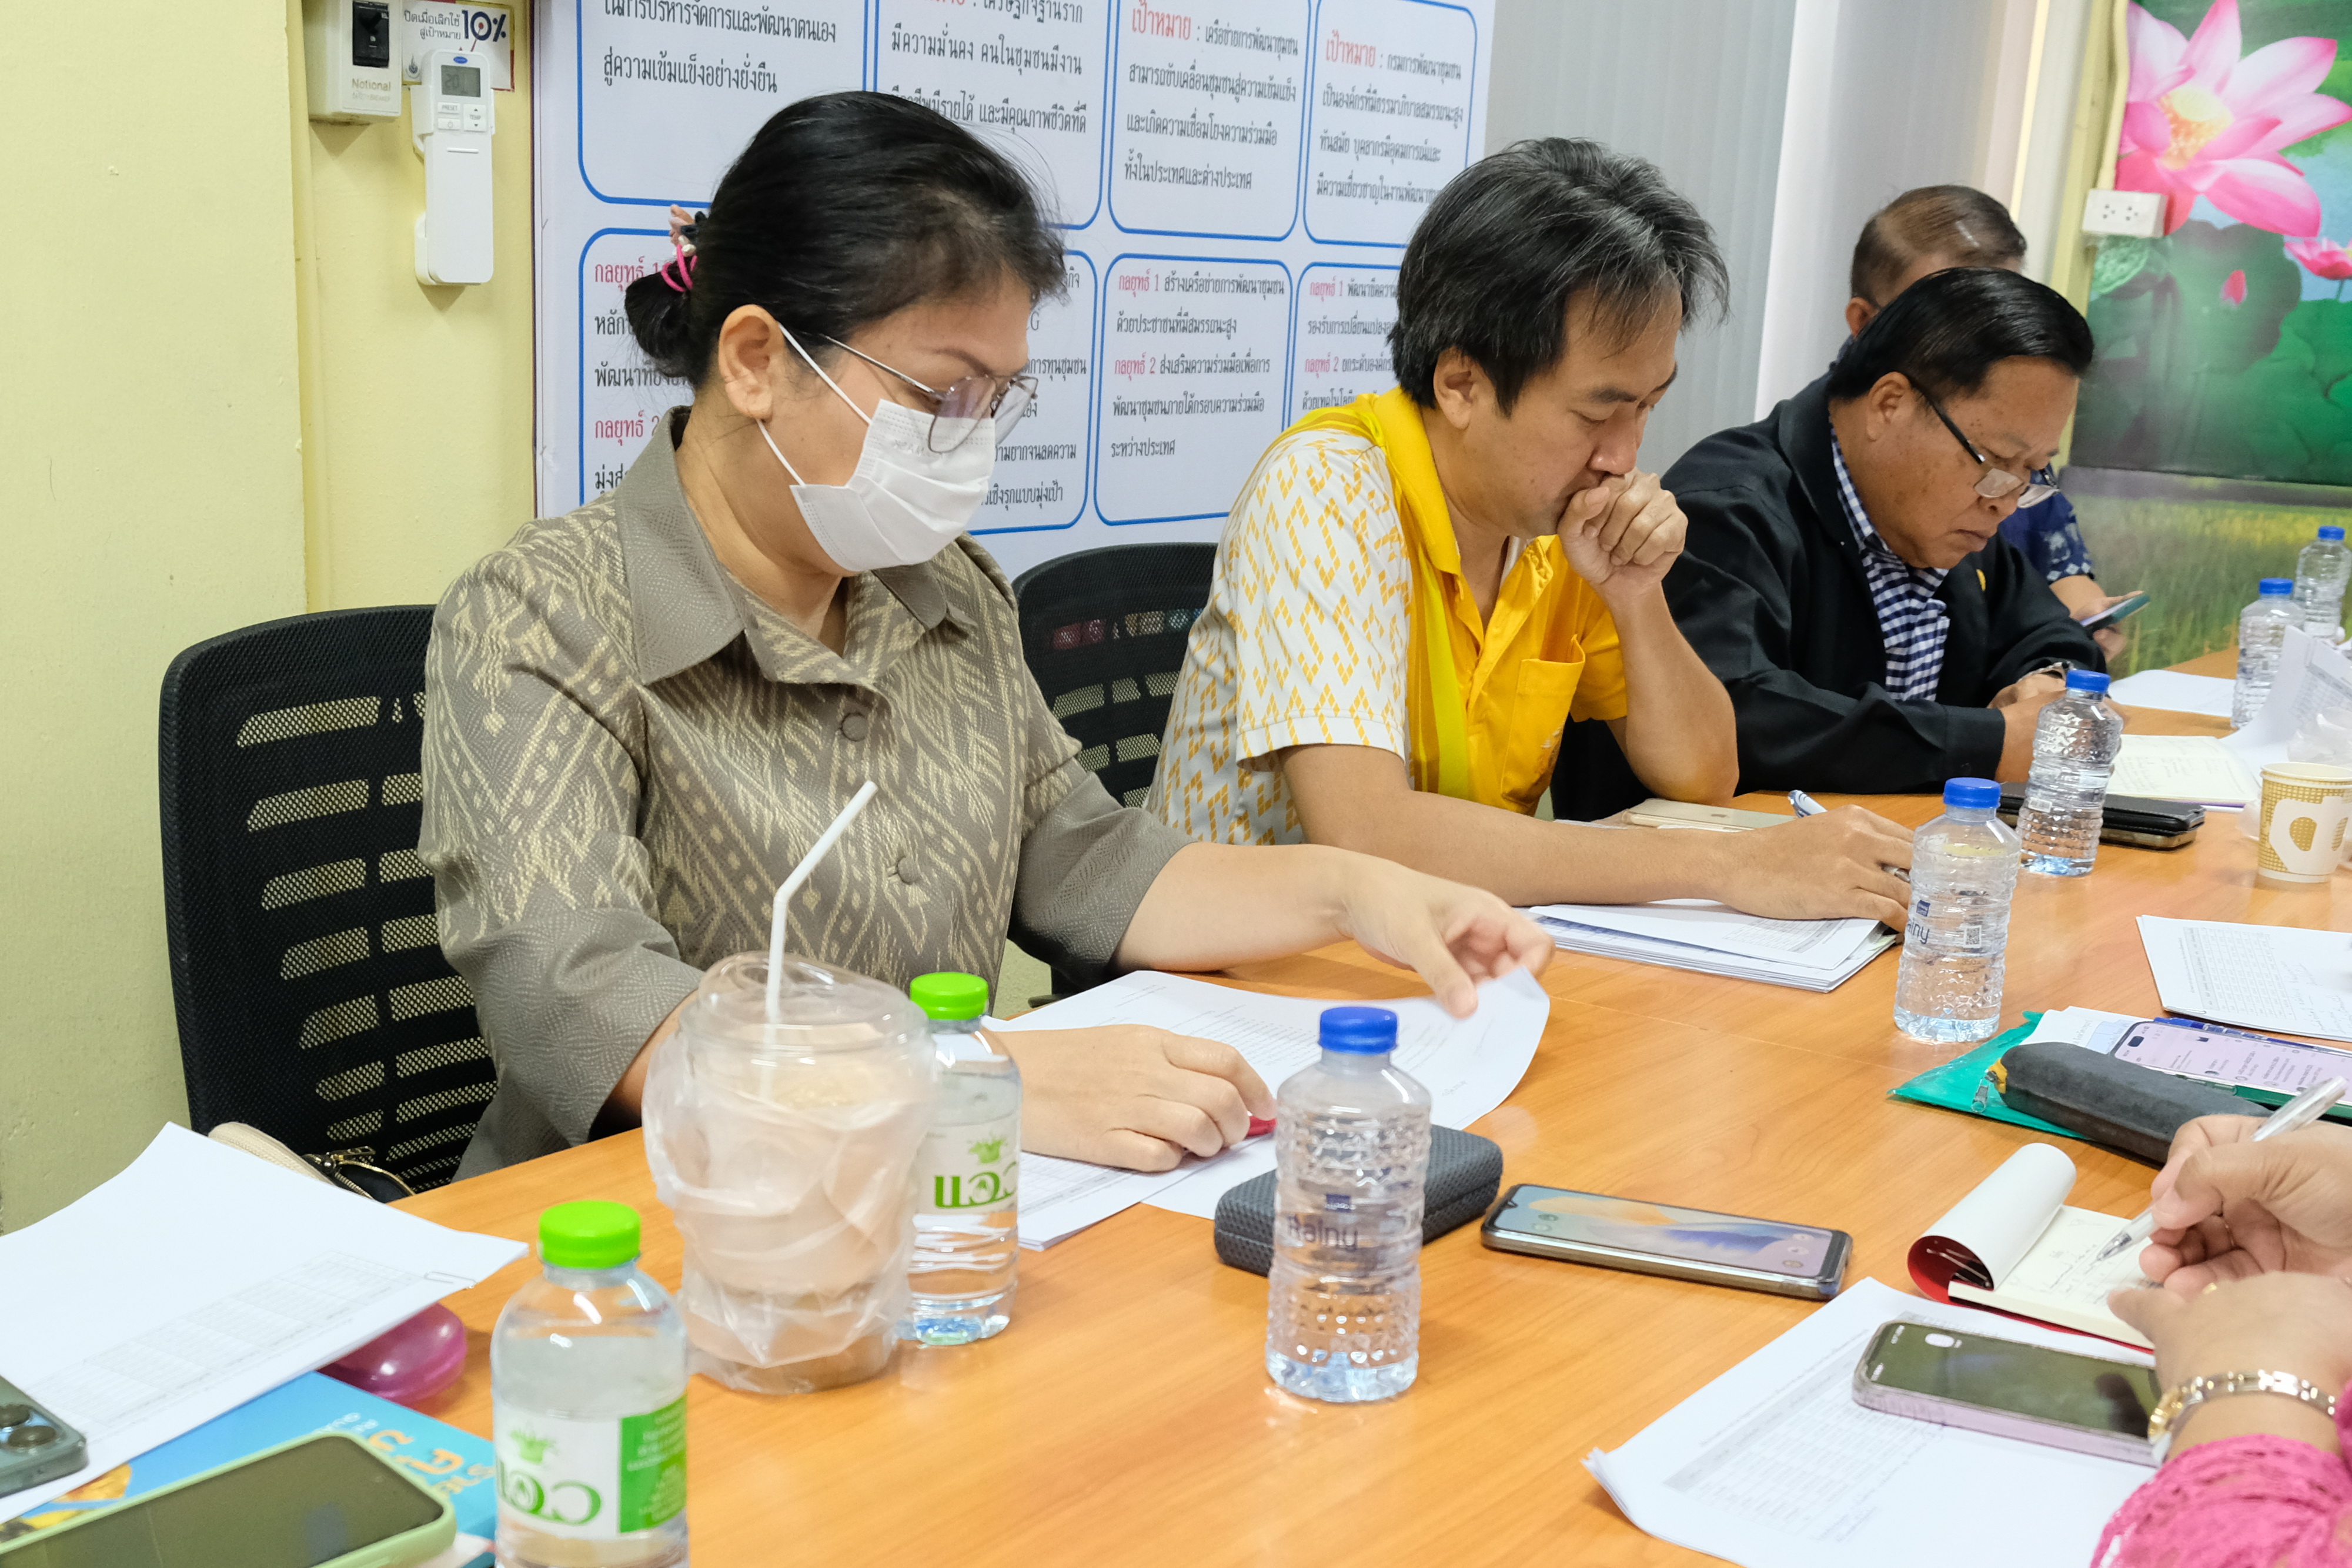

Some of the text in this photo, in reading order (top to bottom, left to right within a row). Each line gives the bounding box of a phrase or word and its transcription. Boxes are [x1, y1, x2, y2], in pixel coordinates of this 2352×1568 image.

[403, 8, 460, 26] ปิดเมื่อเลิกใช้
[420, 25, 461, 41] สู่เป้าหมาย
[461, 9, 507, 43] 10%
[891, 22, 1082, 75] มีความมั่นคง คนในชุมชนมีงาน
[1325, 29, 1377, 68] เป้าหมาย
[603, 46, 777, 93] สู่ความเข้มแข็งอย่างยั่งยืน
[978, 97, 1087, 134] และมีคุณภาพชีวิตที่ดี
[1124, 148, 1252, 190] ทั้งในประเทศและต่างประเทศ
[1118, 268, 1285, 300] กลยุทธ์ 1 สร้างเครือข่ายการพัฒนาชุมชน
[1116, 306, 1237, 340] ด้วยประชาชนที่มีสมรรถนะสูง
[1114, 347, 1271, 381] กลยุทธ์ 2 ส่งเสริมความร่วมมือเพื่อการ
[1333, 356, 1339, 372] 2
[1112, 390, 1265, 422] พัฒนาชุมชนภายใต้กรอบความร่วมมือ
[595, 409, 645, 446] กลยุทธ์
[1111, 436, 1176, 458] ระหว่างประเทศ
